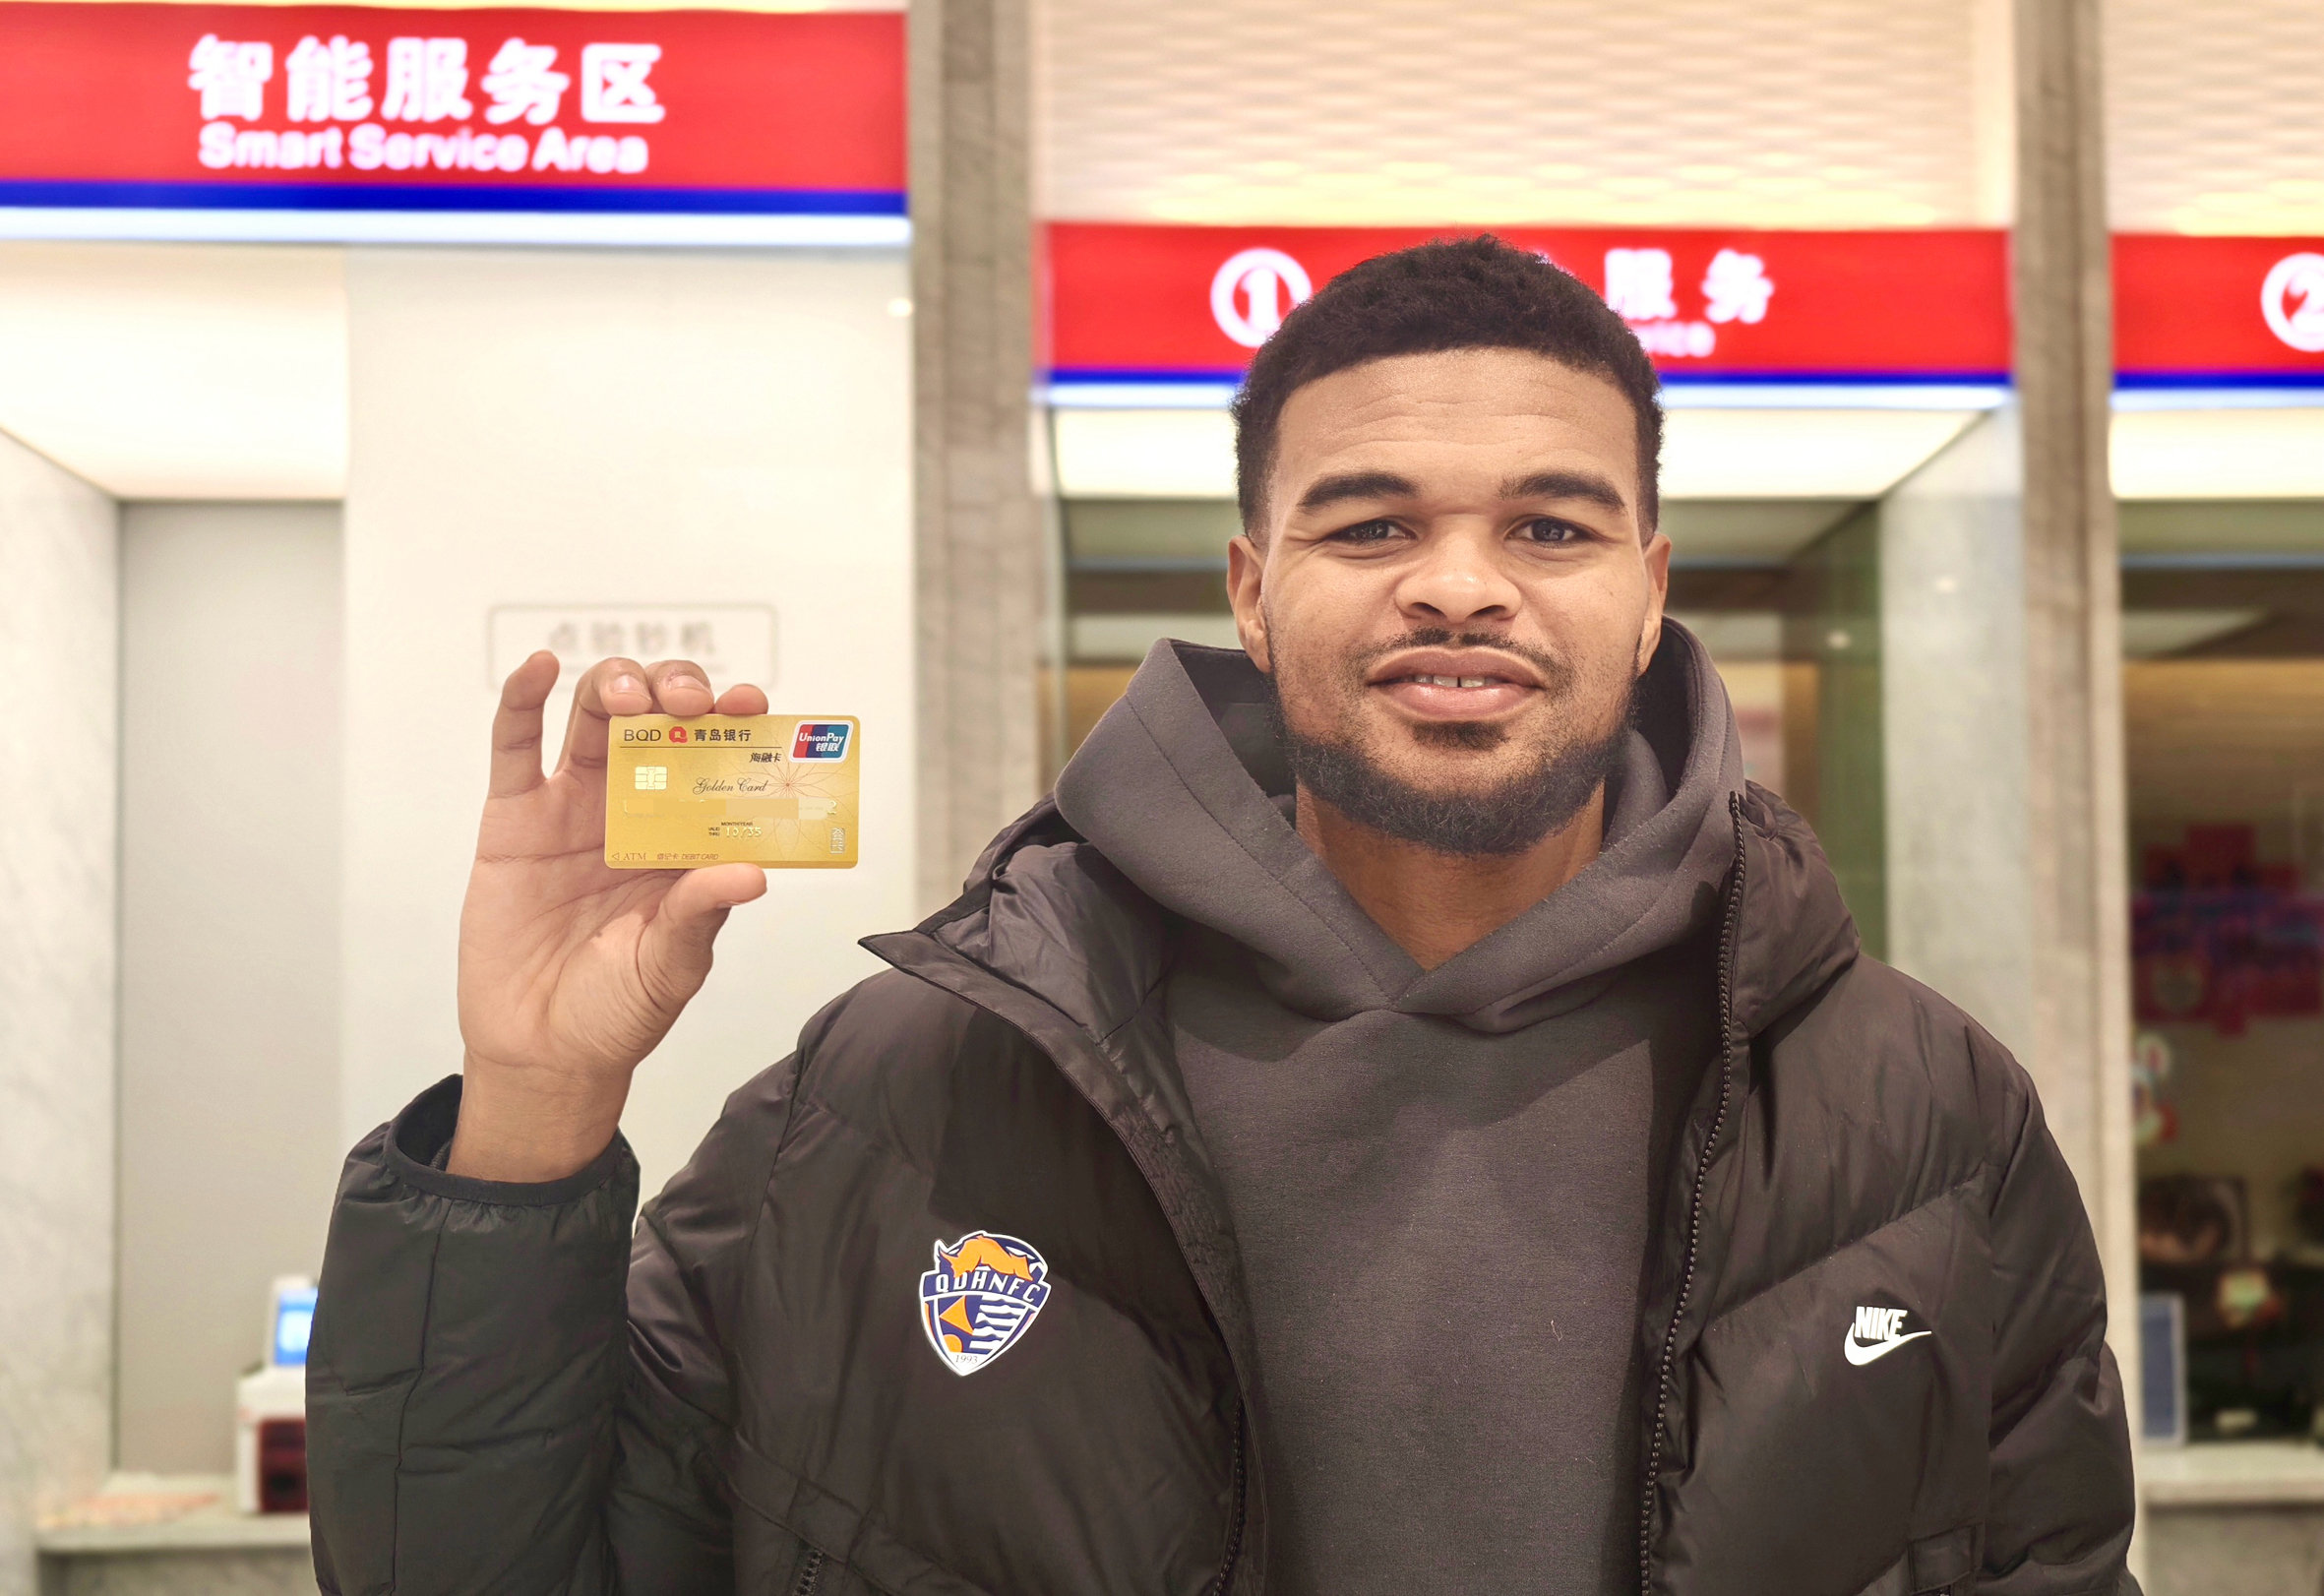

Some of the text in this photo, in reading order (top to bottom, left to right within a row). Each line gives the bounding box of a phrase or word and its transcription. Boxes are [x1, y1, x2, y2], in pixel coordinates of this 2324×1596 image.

[188, 33, 665, 125] 智能服务区
[198, 121, 649, 173] Smart Service Area
[624, 729, 661, 741] BQD
[694, 729, 752, 742] 青岛银行
[799, 732, 844, 745] UnionPay
[816, 742, 839, 752] 银联
[749, 752, 781, 763] 海融卡
[692, 777, 769, 794] Golden Card
[623, 852, 647, 861] ATM
[1855, 1306, 1908, 1341] NIKE
[954, 1354, 979, 1365] 1993
